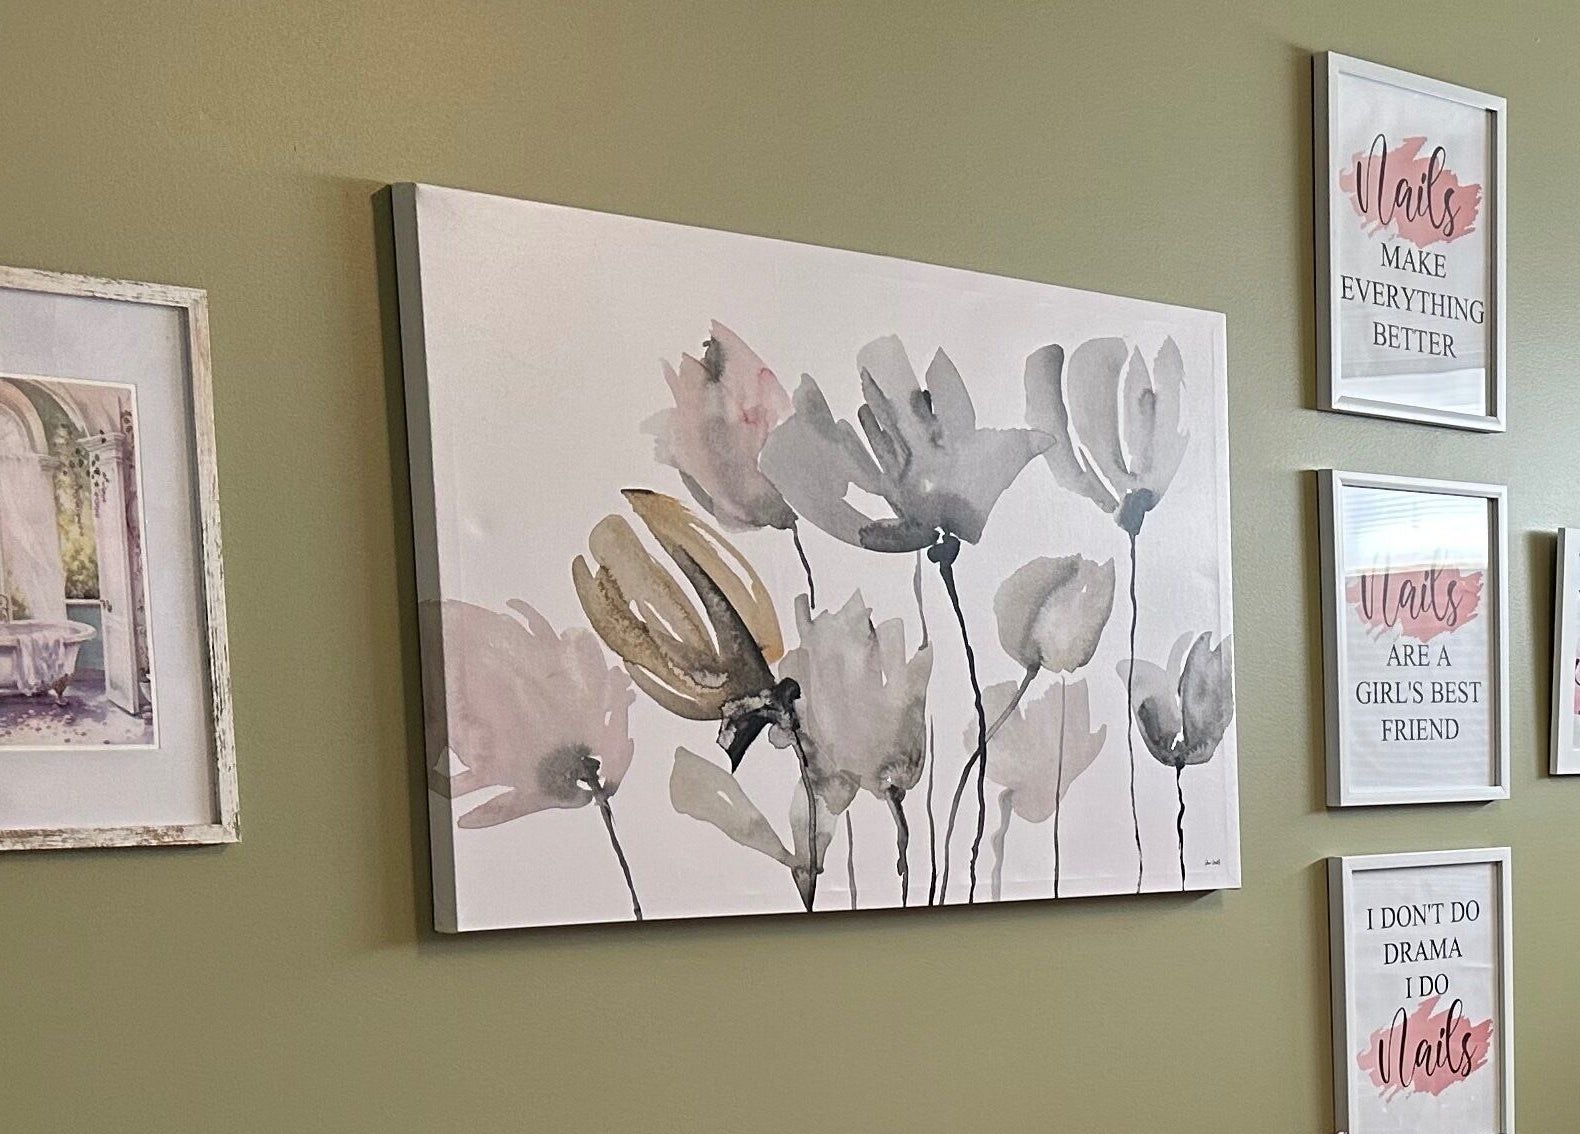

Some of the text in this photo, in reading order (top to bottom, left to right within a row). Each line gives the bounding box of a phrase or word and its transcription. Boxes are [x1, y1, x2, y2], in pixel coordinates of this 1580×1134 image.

[1357, 133, 1461, 237] Nails
[1380, 242, 1447, 279] MAKE
[1341, 275, 1485, 325] EVERYTHING
[1373, 321, 1457, 358] BETTER
[1386, 643, 1452, 668] ARE A
[1356, 681, 1482, 705] GIRL'S BEST
[1381, 718, 1460, 742] FRIEND
[1367, 899, 1481, 930] I DON'T DO
[1384, 936, 1463, 966] DRAMA
[1406, 973, 1449, 999] I DO
[1378, 998, 1478, 1089] Nails
